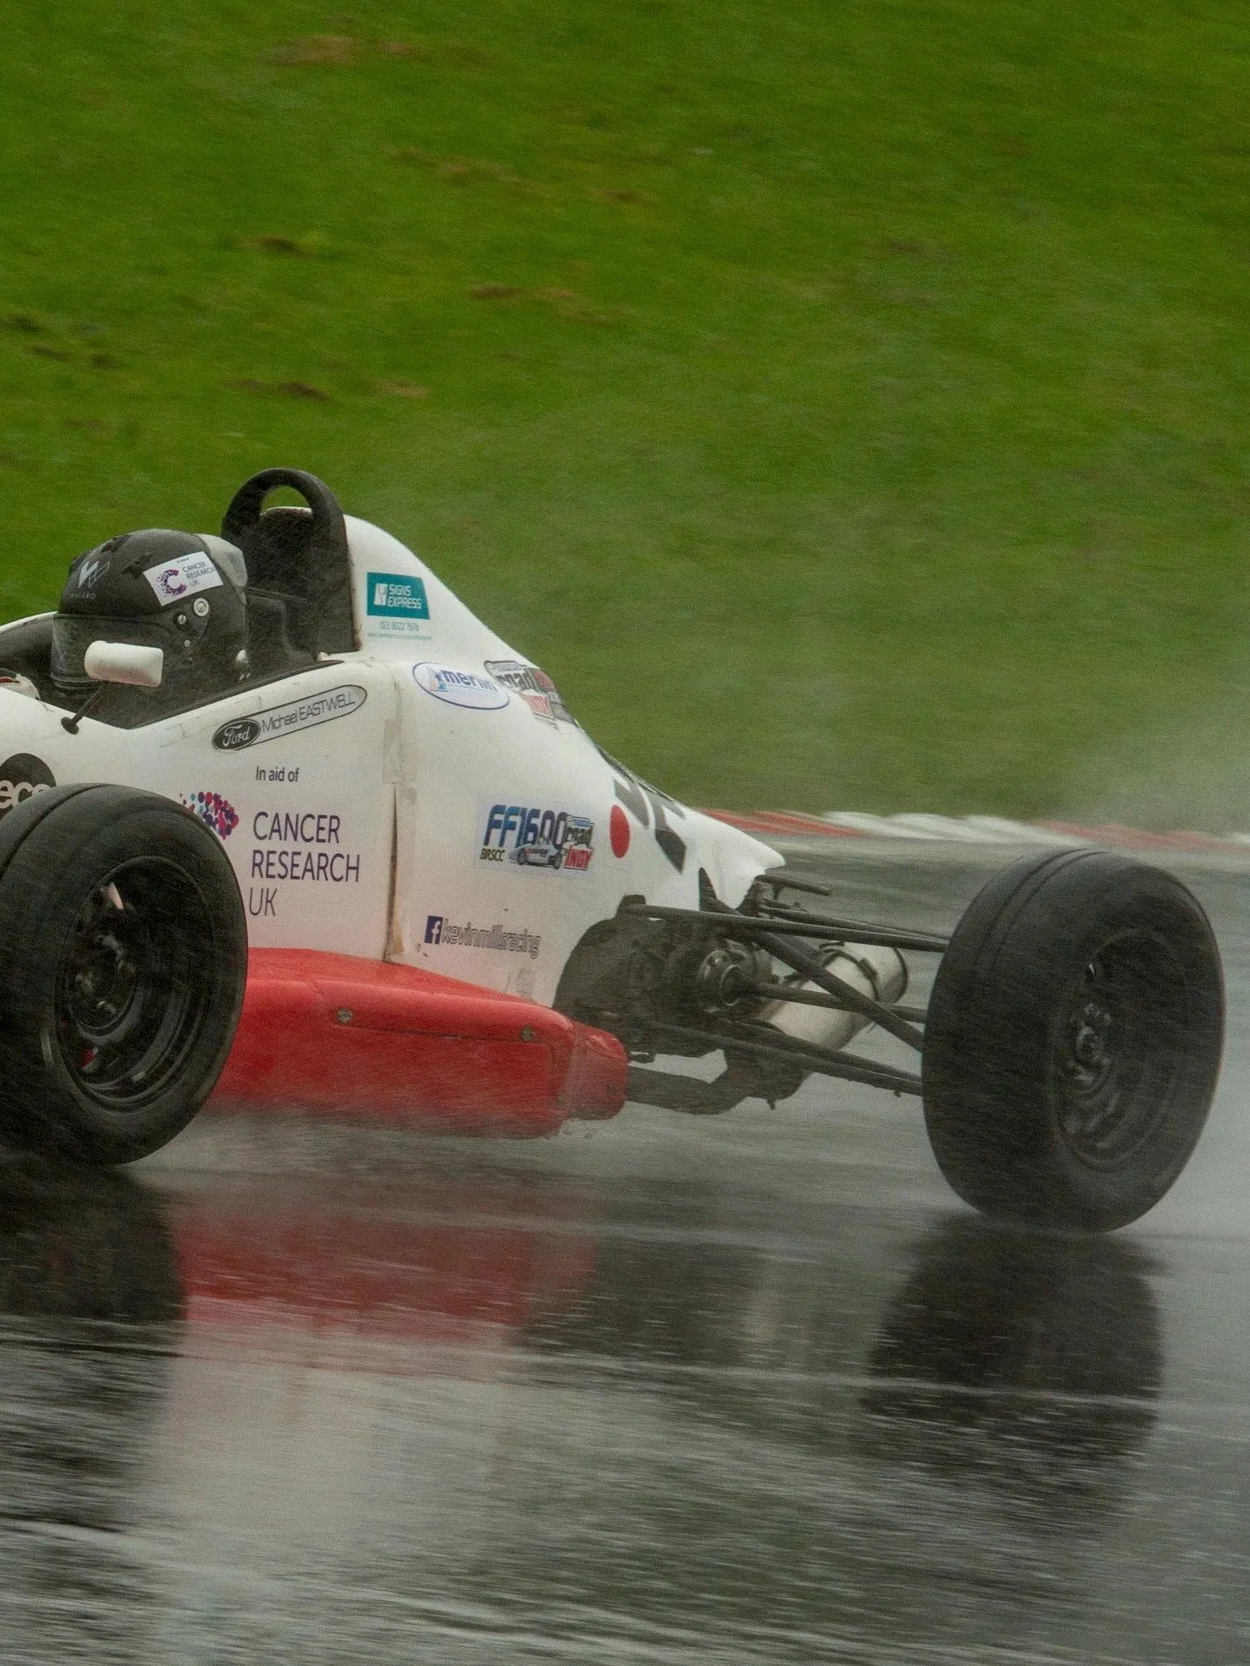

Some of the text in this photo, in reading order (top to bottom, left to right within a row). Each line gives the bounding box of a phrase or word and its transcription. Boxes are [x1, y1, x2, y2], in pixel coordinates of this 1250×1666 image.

[222, 692, 356, 747] Ford Michael EASTWELL
[255, 765, 300, 783] In aid of
[253, 811, 341, 844] CANCER
[483, 804, 567, 849] FF1600
[251, 849, 360, 883] RESEARCH
[249, 887, 278, 917] UK
